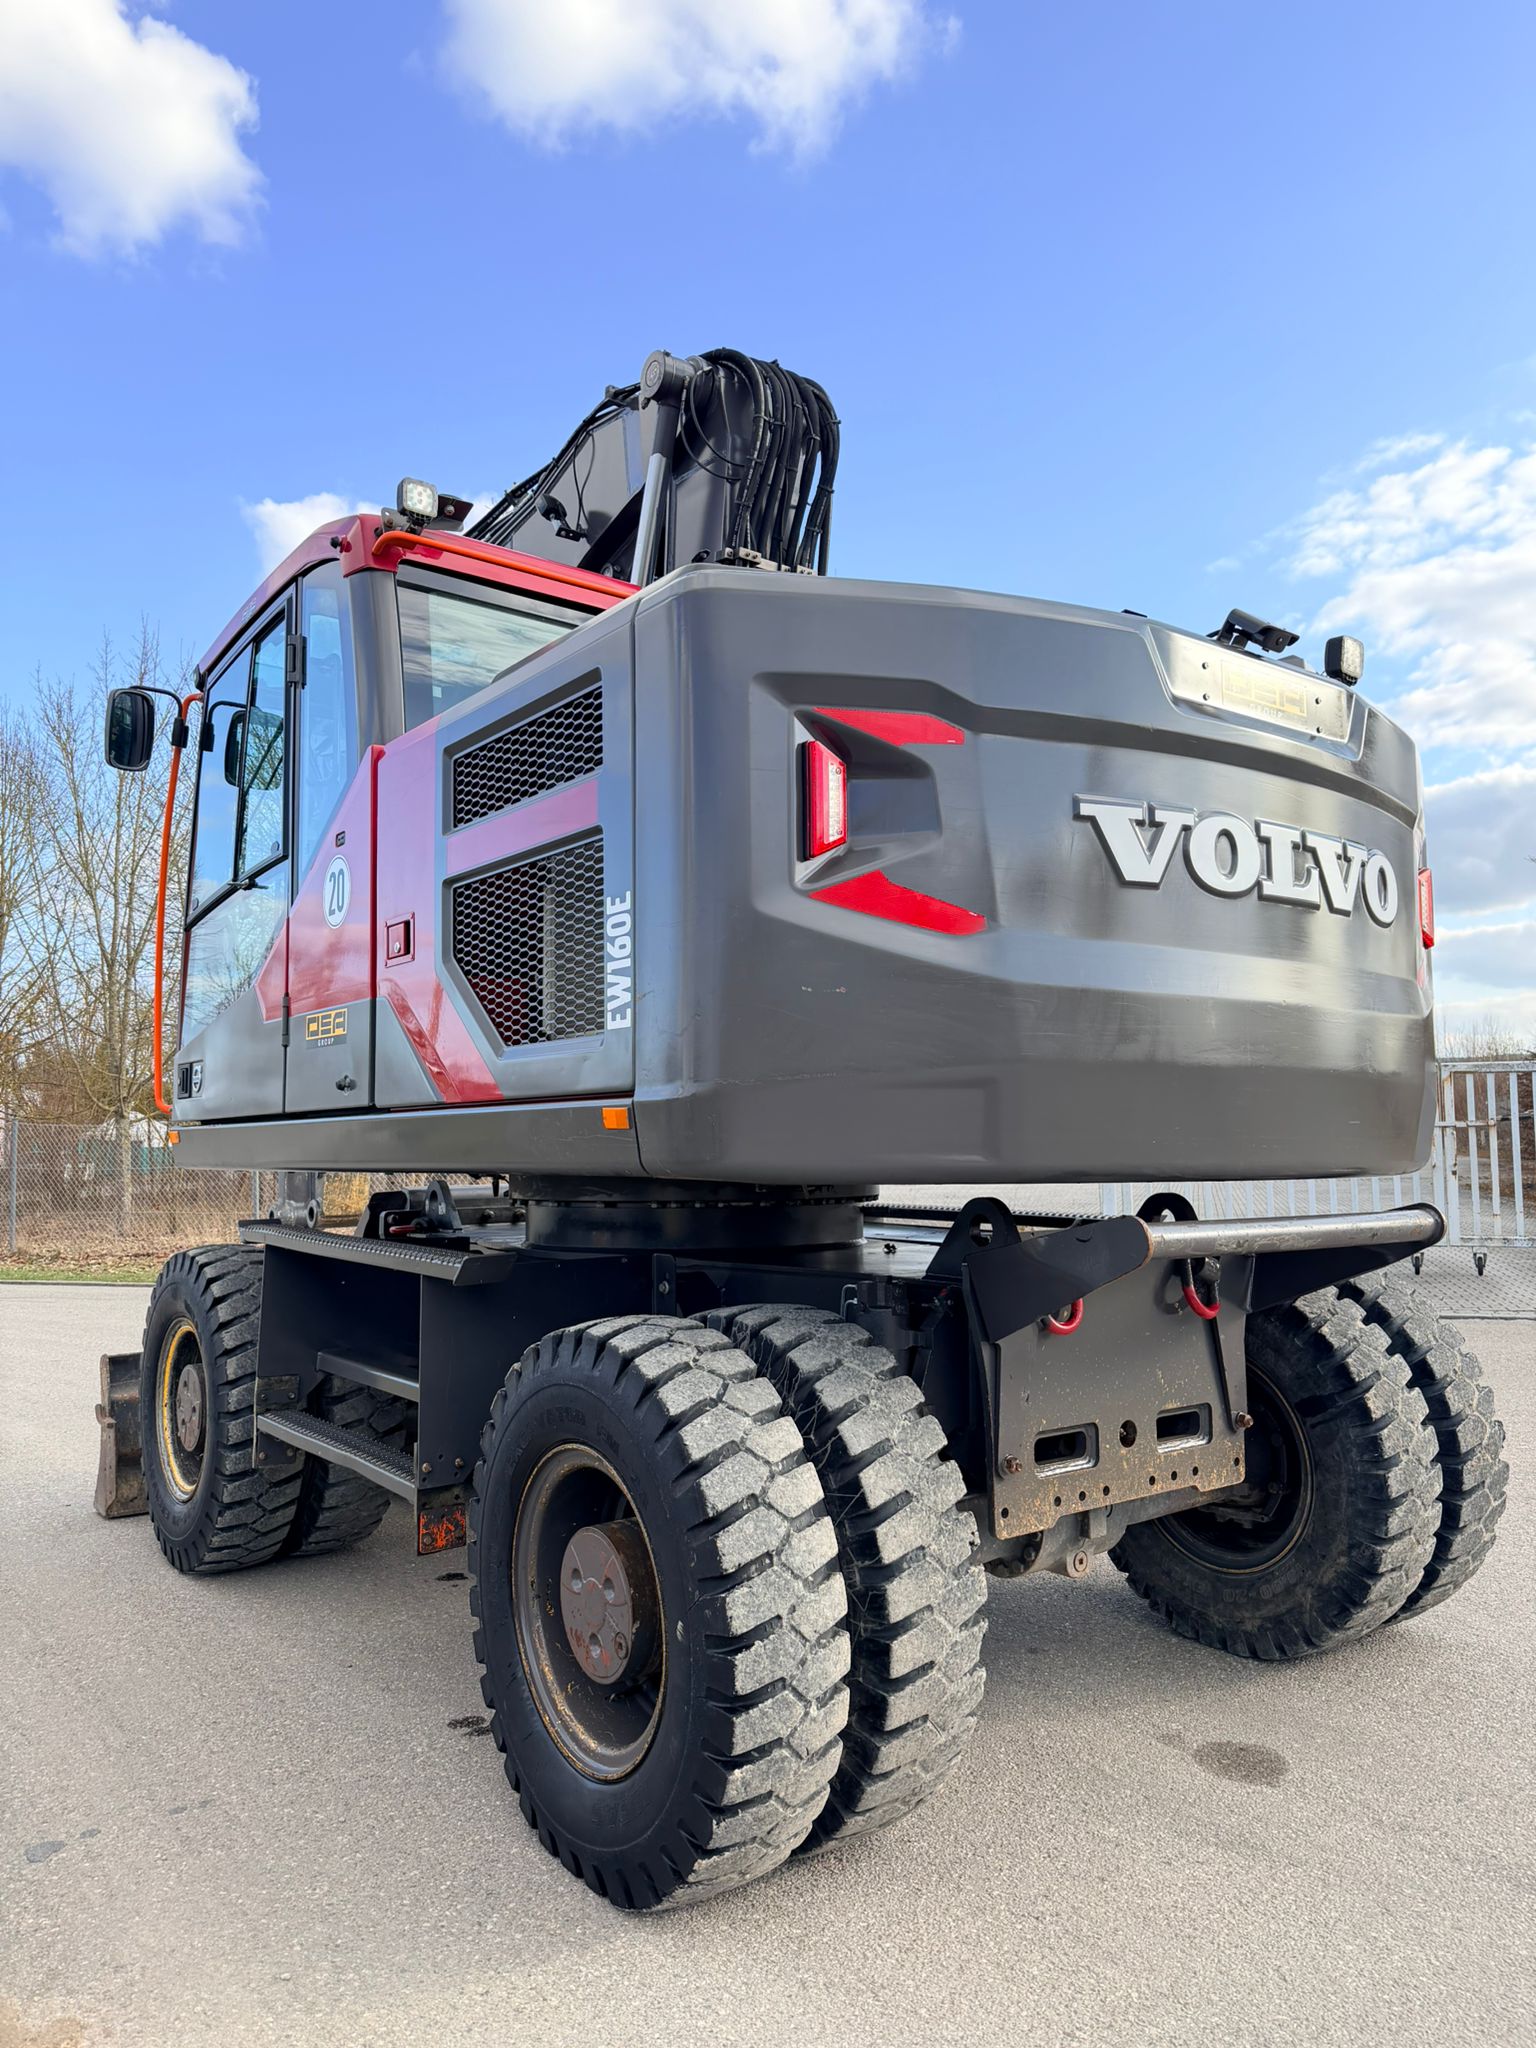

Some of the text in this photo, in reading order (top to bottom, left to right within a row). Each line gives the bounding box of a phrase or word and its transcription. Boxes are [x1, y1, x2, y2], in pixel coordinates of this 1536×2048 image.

[328, 868, 345, 917] 20
[1073, 793, 1400, 929] VOLVO
[606, 891, 632, 1030] EW160E
